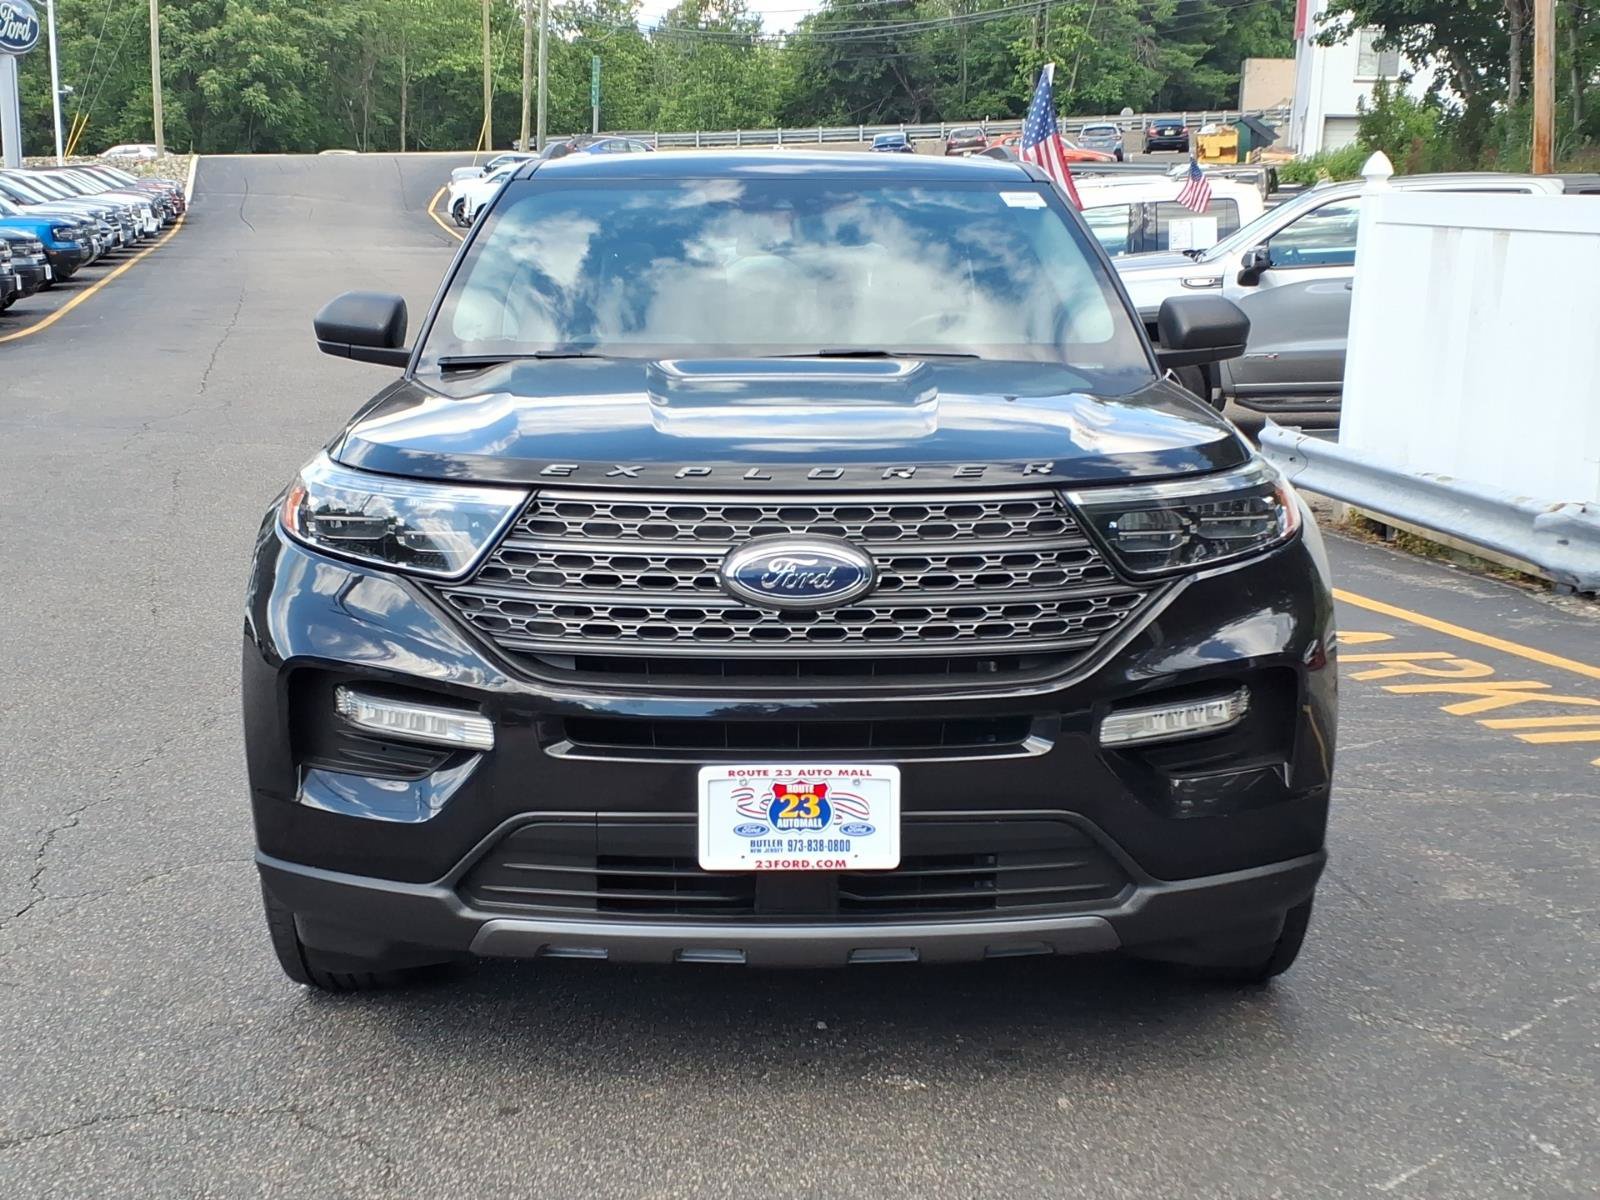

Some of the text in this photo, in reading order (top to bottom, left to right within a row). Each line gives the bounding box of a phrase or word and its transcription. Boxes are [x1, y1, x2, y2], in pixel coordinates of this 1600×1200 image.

[0, 2, 31, 41] Ford
[539, 460, 1055, 480] EXPLORER
[760, 557, 838, 589] Ford
[727, 769, 873, 777] ROUTE 23 AUTO MALL
[786, 783, 815, 794] ROUTE
[778, 793, 821, 819] 23
[776, 817, 823, 829] AUTOMALL
[750, 839, 851, 852] BUTLER 973-838-0800
[755, 859, 847, 869] 23FORD.COM
